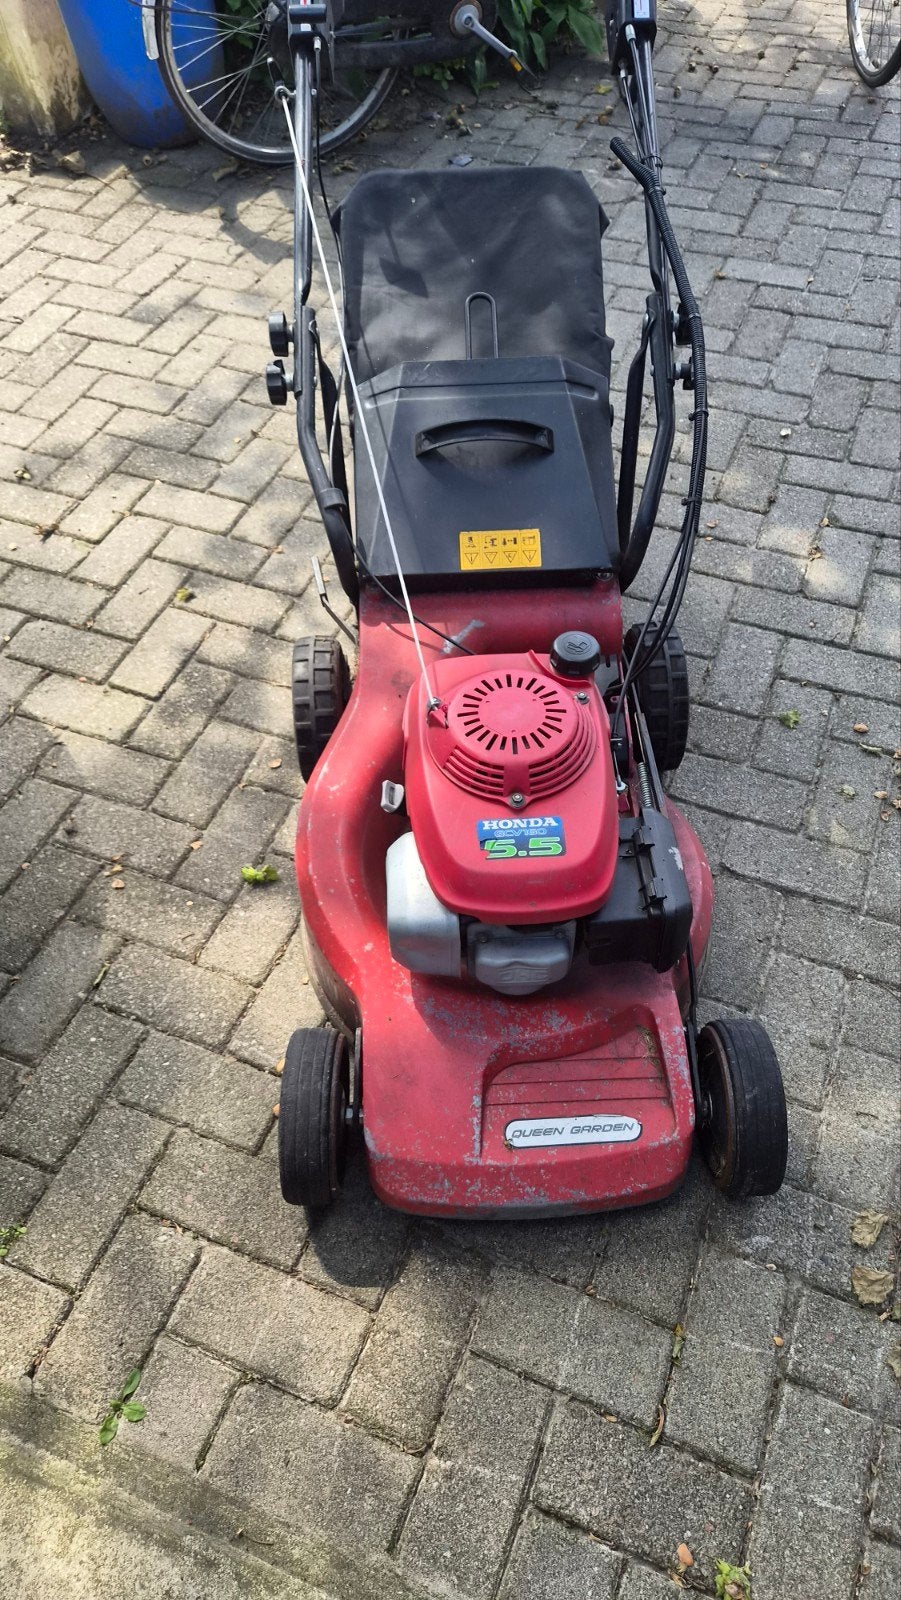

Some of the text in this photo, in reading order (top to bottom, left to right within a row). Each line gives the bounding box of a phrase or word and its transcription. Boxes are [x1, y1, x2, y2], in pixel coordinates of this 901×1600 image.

[482, 817, 559, 830] HONDA
[484, 837, 563, 859] 5.5
[511, 1122, 635, 1139] QUEEN GARDEN
